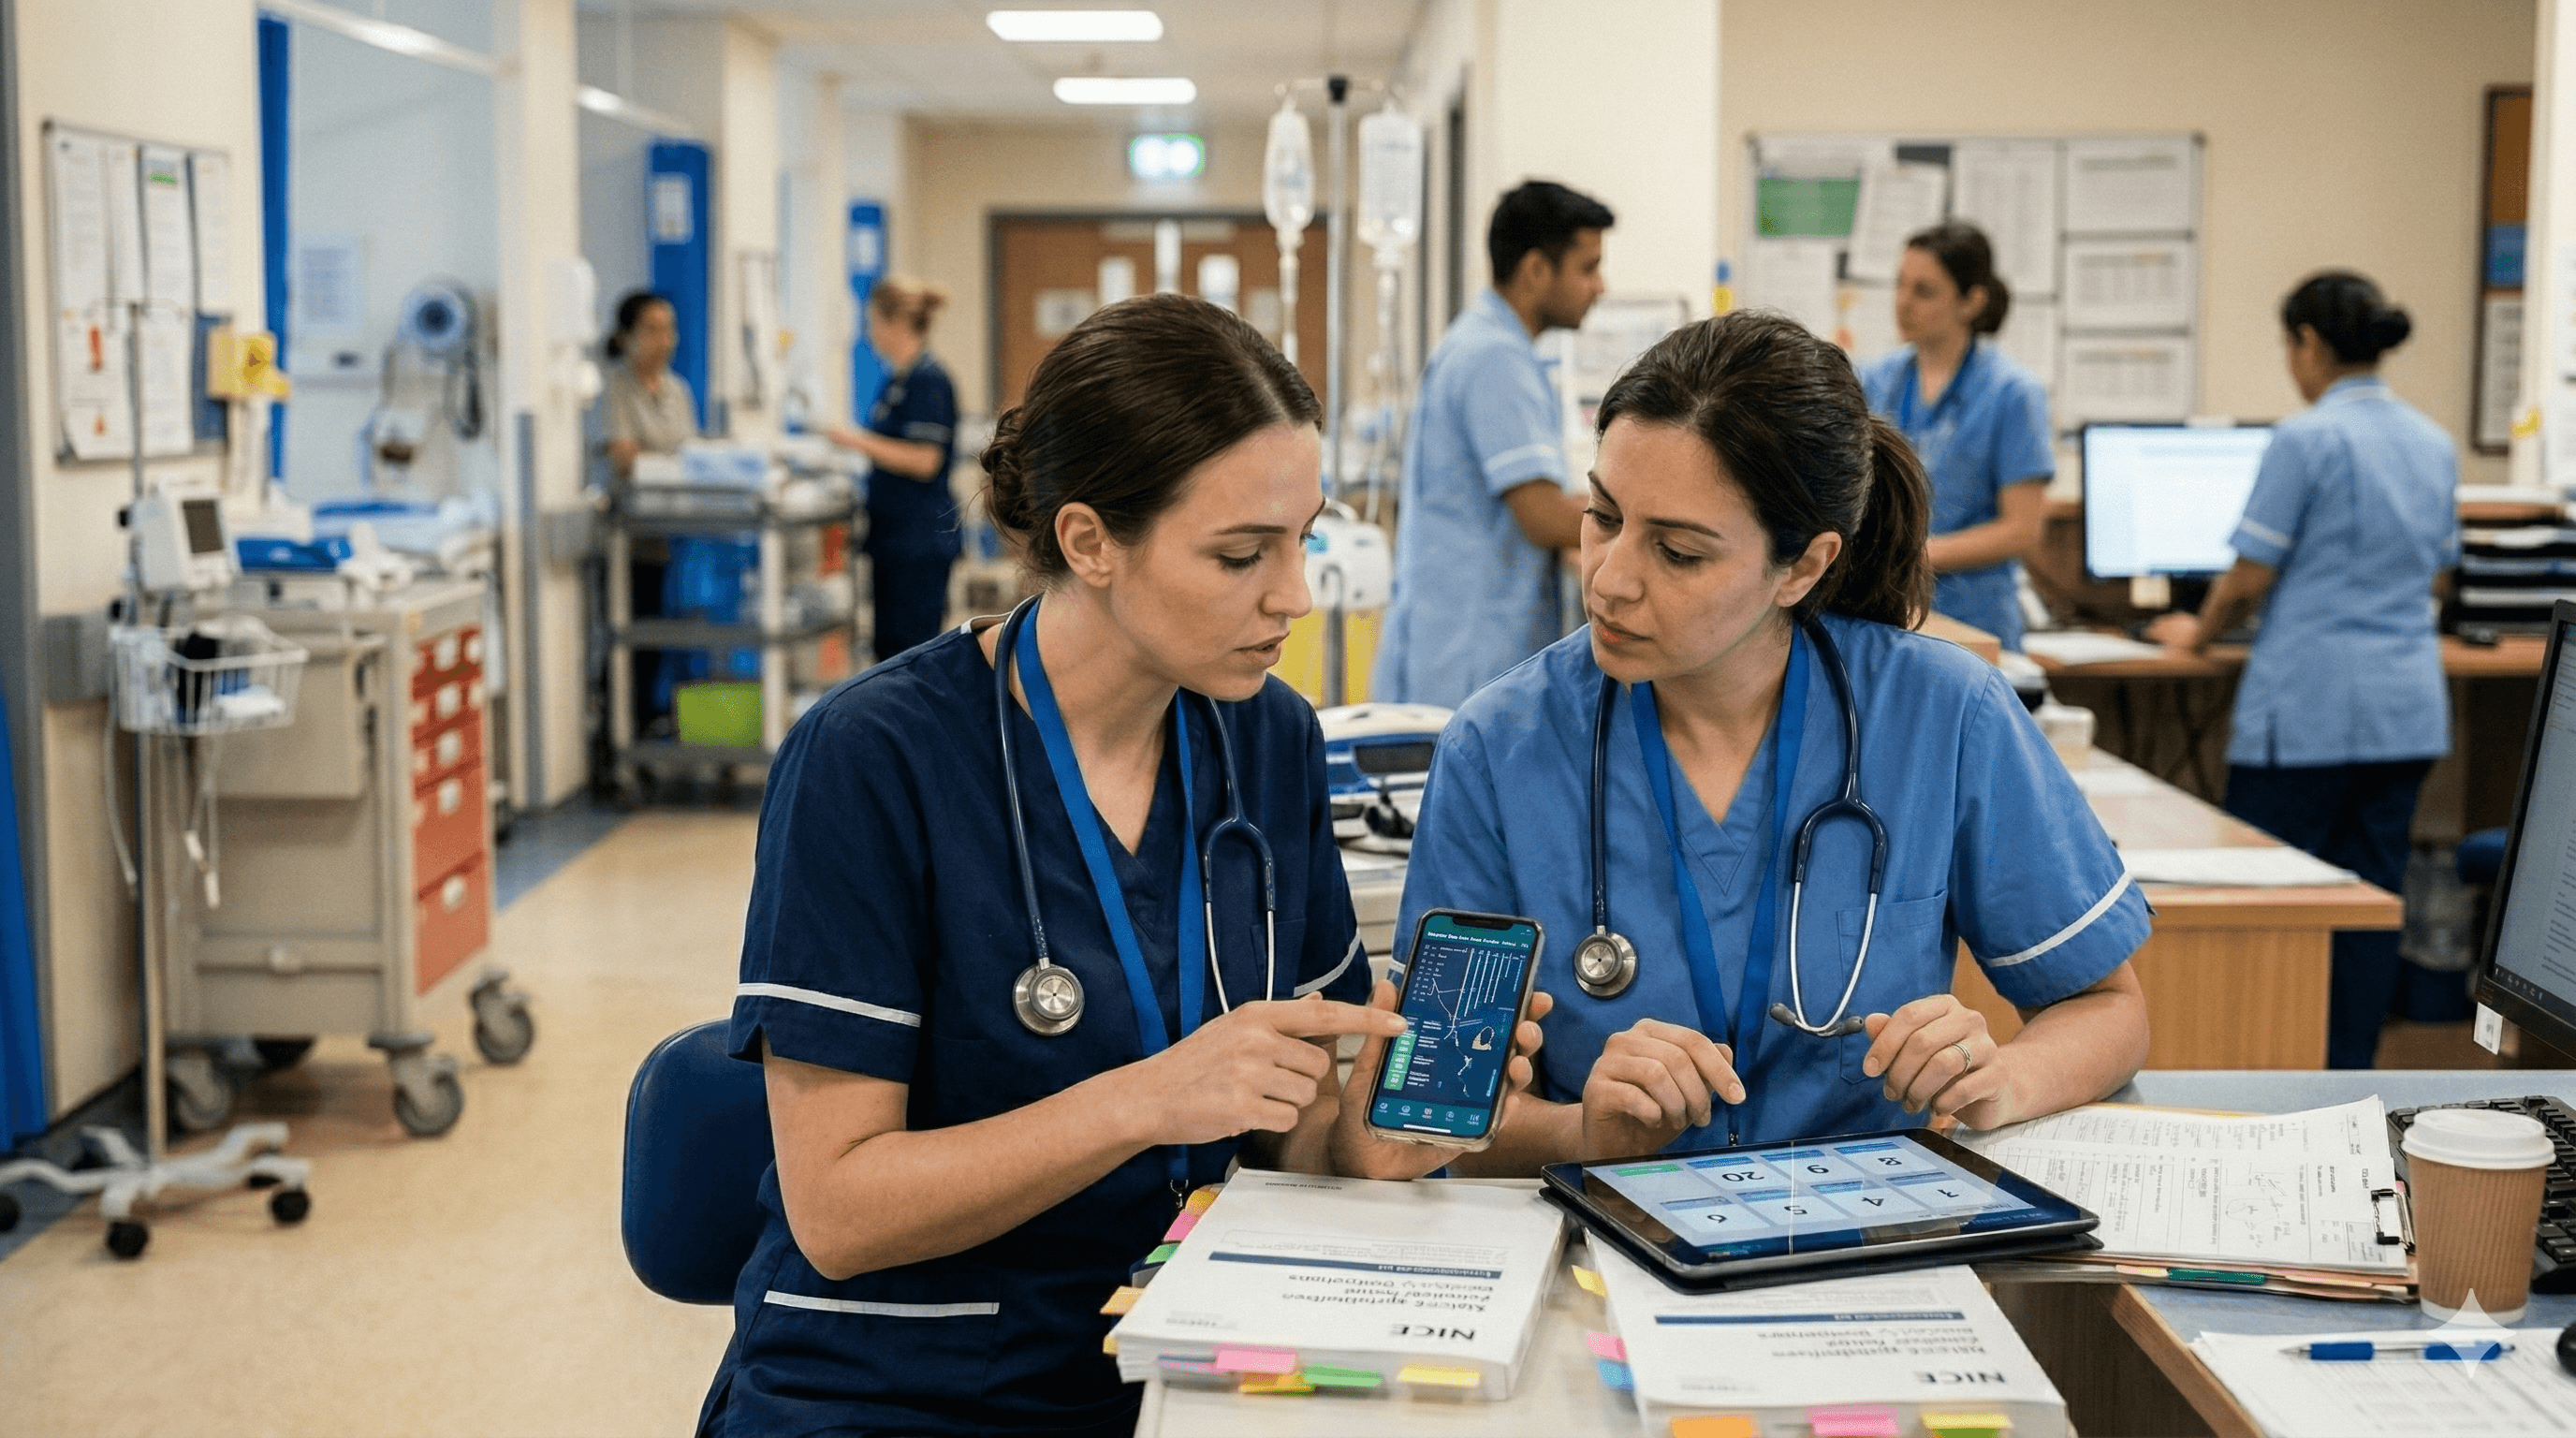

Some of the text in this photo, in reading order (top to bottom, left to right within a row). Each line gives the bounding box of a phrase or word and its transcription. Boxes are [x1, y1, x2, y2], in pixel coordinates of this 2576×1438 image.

[1807, 1165, 1829, 1174] 9
[1721, 1171, 1765, 1182] 20
[1861, 1196, 1884, 1208] 4
[1784, 1205, 1808, 1215] 5
[1390, 1323, 1477, 1342] NICE
[1914, 1371, 2006, 1385] NICE
